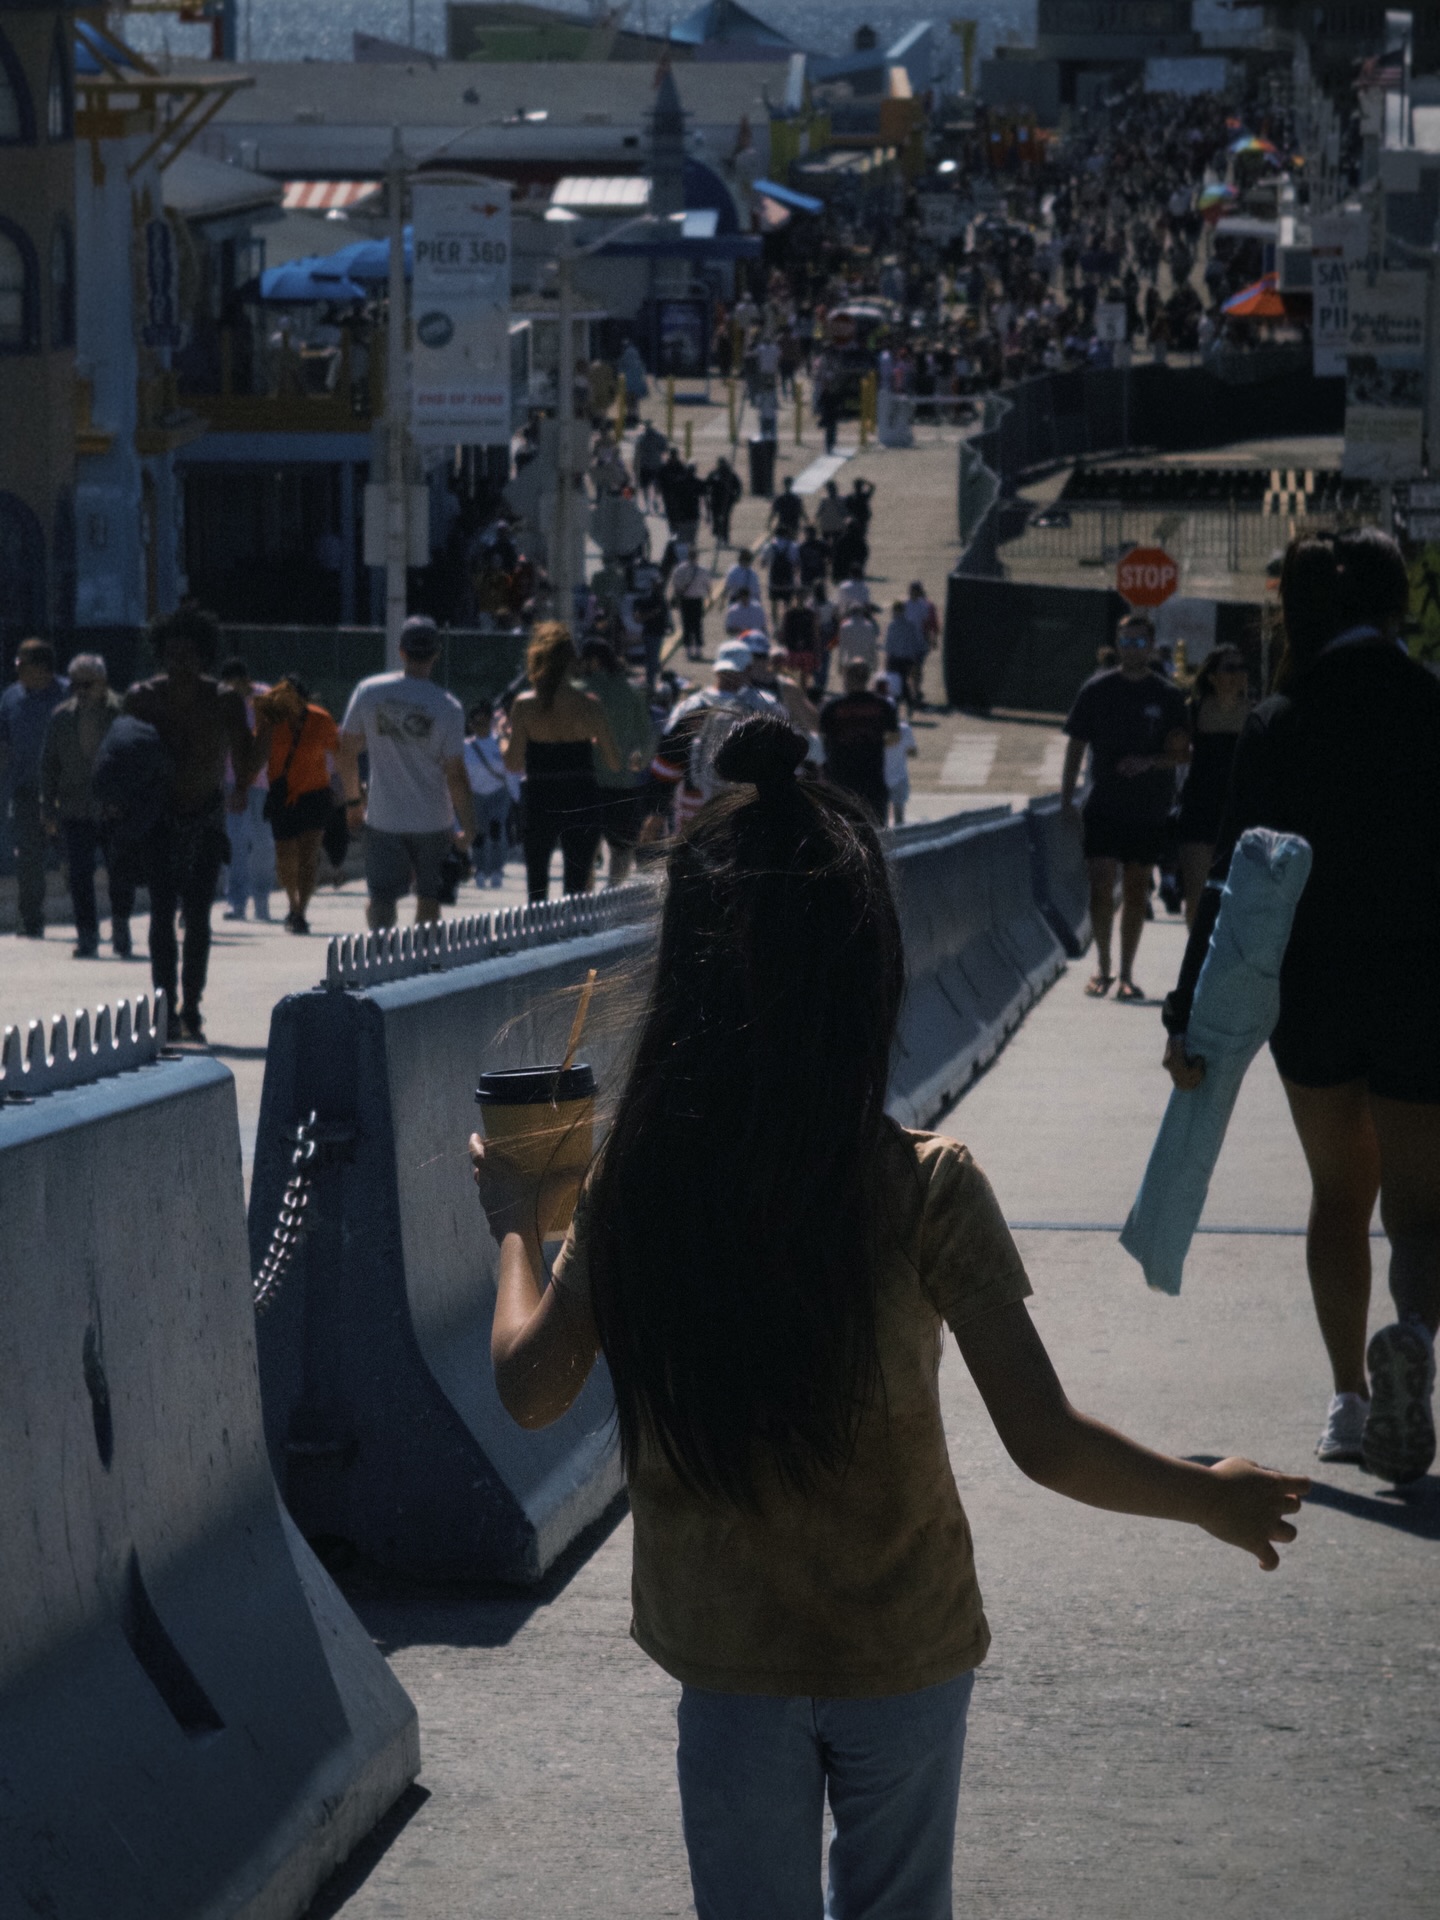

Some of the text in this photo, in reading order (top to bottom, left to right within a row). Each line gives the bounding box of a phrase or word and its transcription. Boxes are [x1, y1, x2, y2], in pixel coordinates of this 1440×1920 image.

[417, 240, 507, 264] PIER 360
[1120, 565, 1176, 589] STOP
